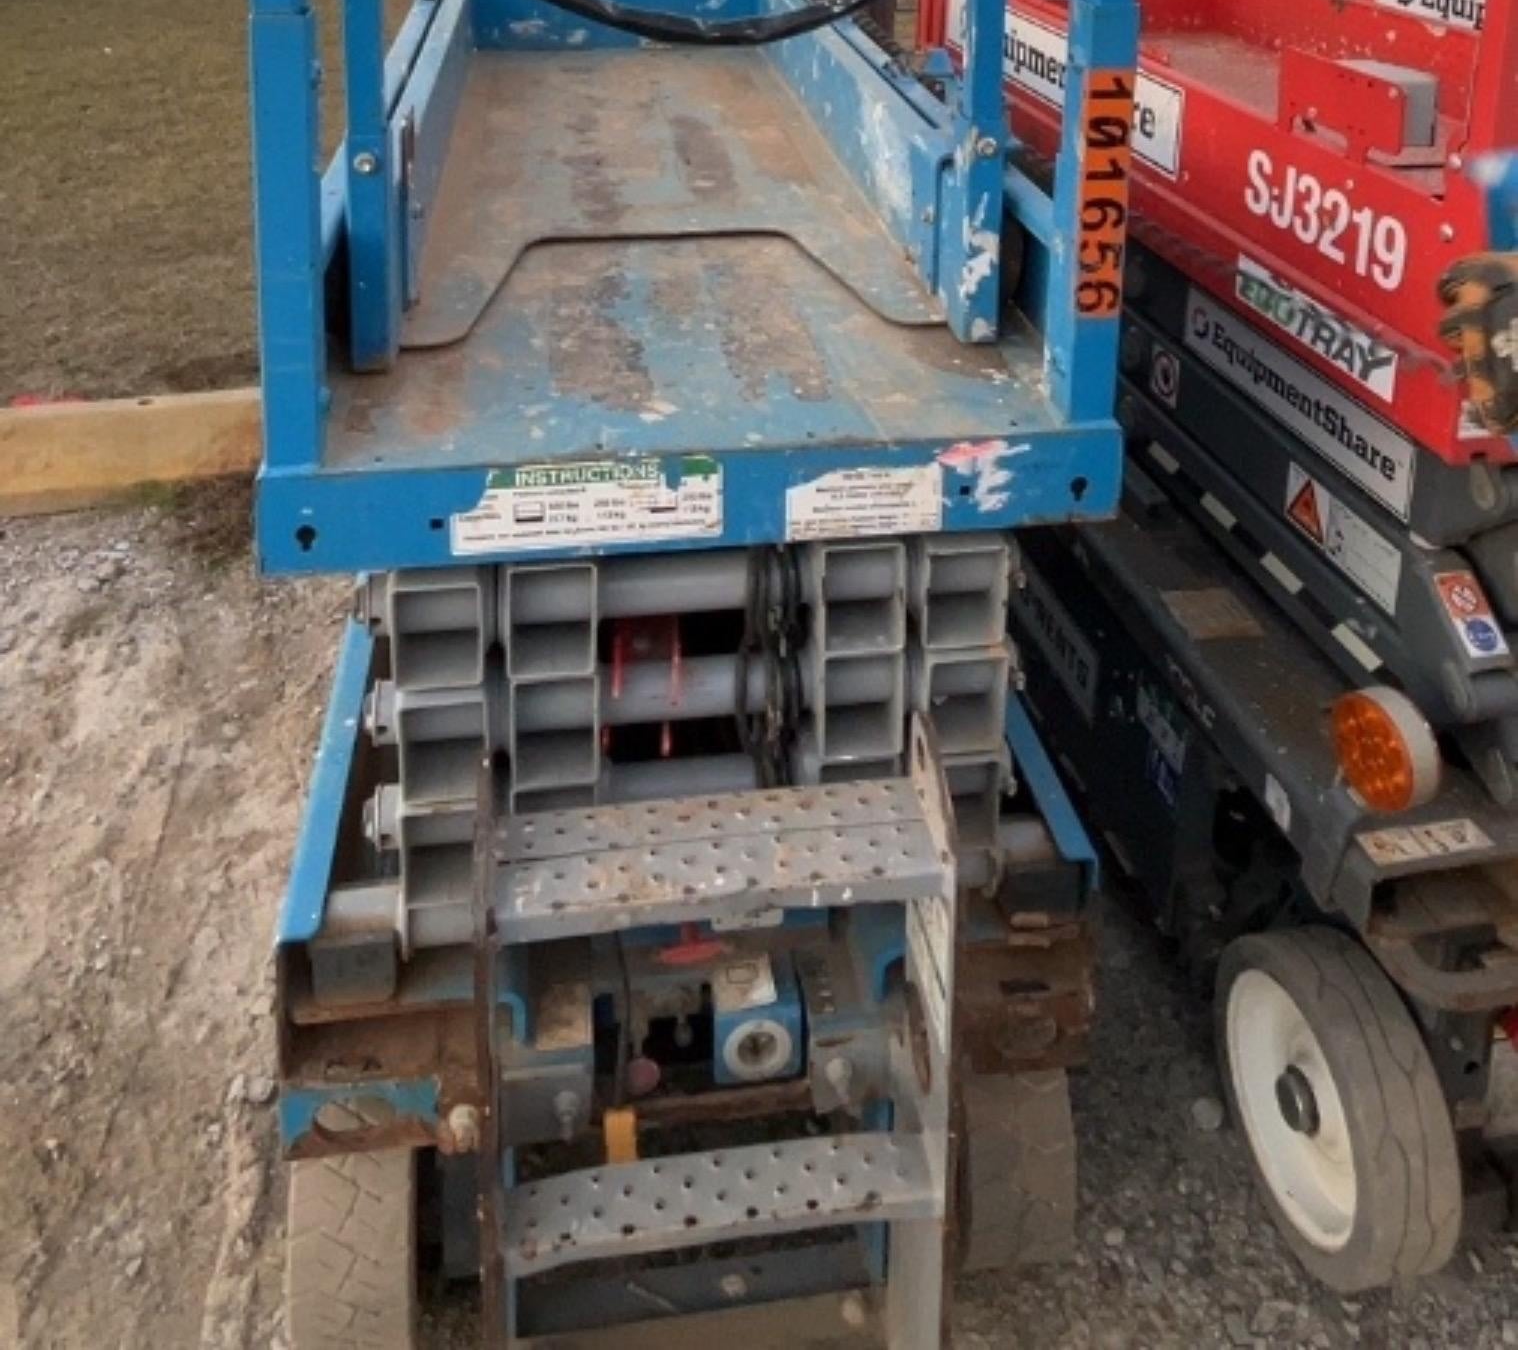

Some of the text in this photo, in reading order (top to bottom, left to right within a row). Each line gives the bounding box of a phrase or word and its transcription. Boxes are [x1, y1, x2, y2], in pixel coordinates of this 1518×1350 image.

[1076, 77, 1133, 313] 101656
[1244, 149, 1408, 292] SJ3219
[1212, 320, 1397, 481] EquipmentShare
